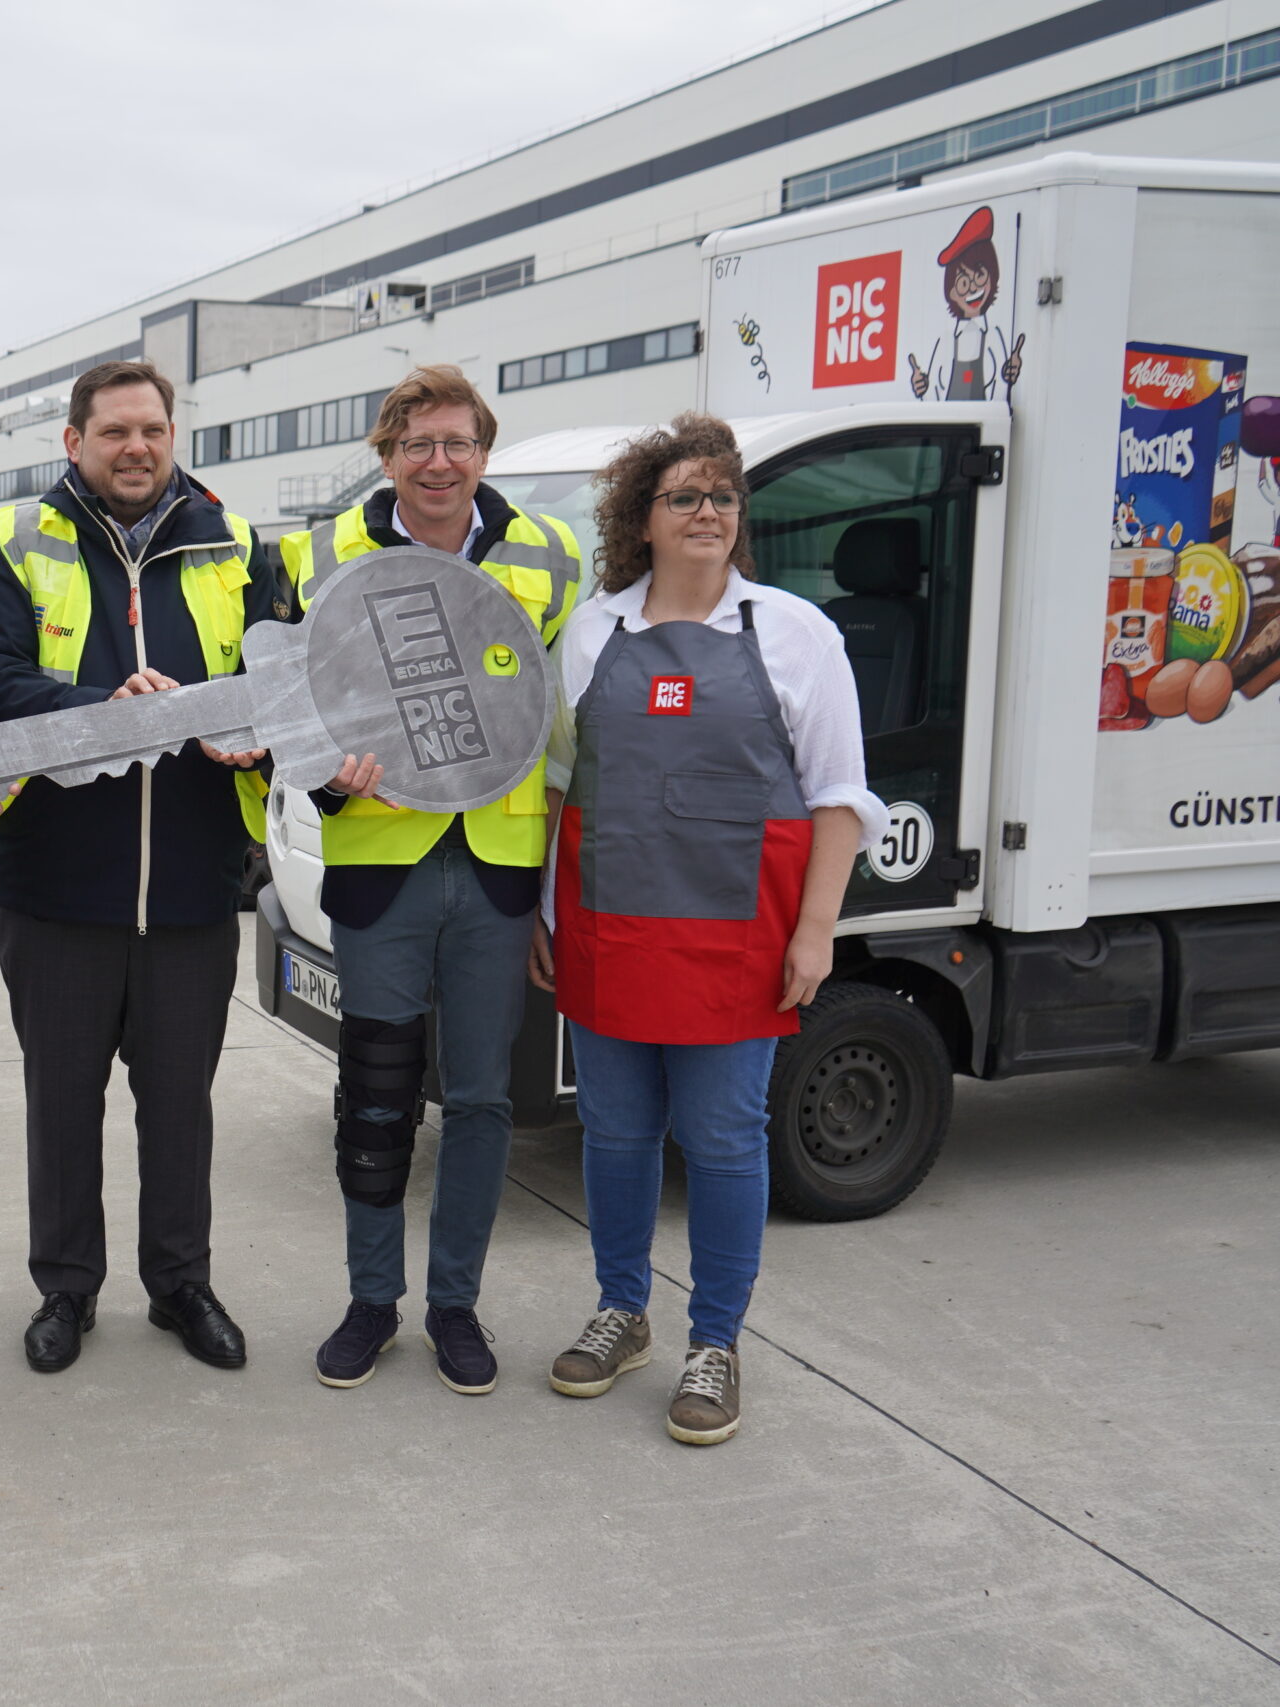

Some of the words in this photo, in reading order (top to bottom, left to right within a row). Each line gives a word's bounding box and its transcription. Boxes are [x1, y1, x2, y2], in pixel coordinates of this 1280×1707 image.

[715, 256, 741, 279] 677
[828, 277, 886, 324] PIC
[1128, 357, 1196, 399] Kellogg's
[1120, 427, 1195, 478] FROSTIES
[394, 657, 457, 680] EDEKA
[1112, 640, 1150, 659] Extra
[657, 682, 686, 695] PIC
[402, 690, 472, 731] PIC
[881, 817, 920, 867] 50
[292, 961, 300, 993] D
[309, 970, 326, 1009] PN
